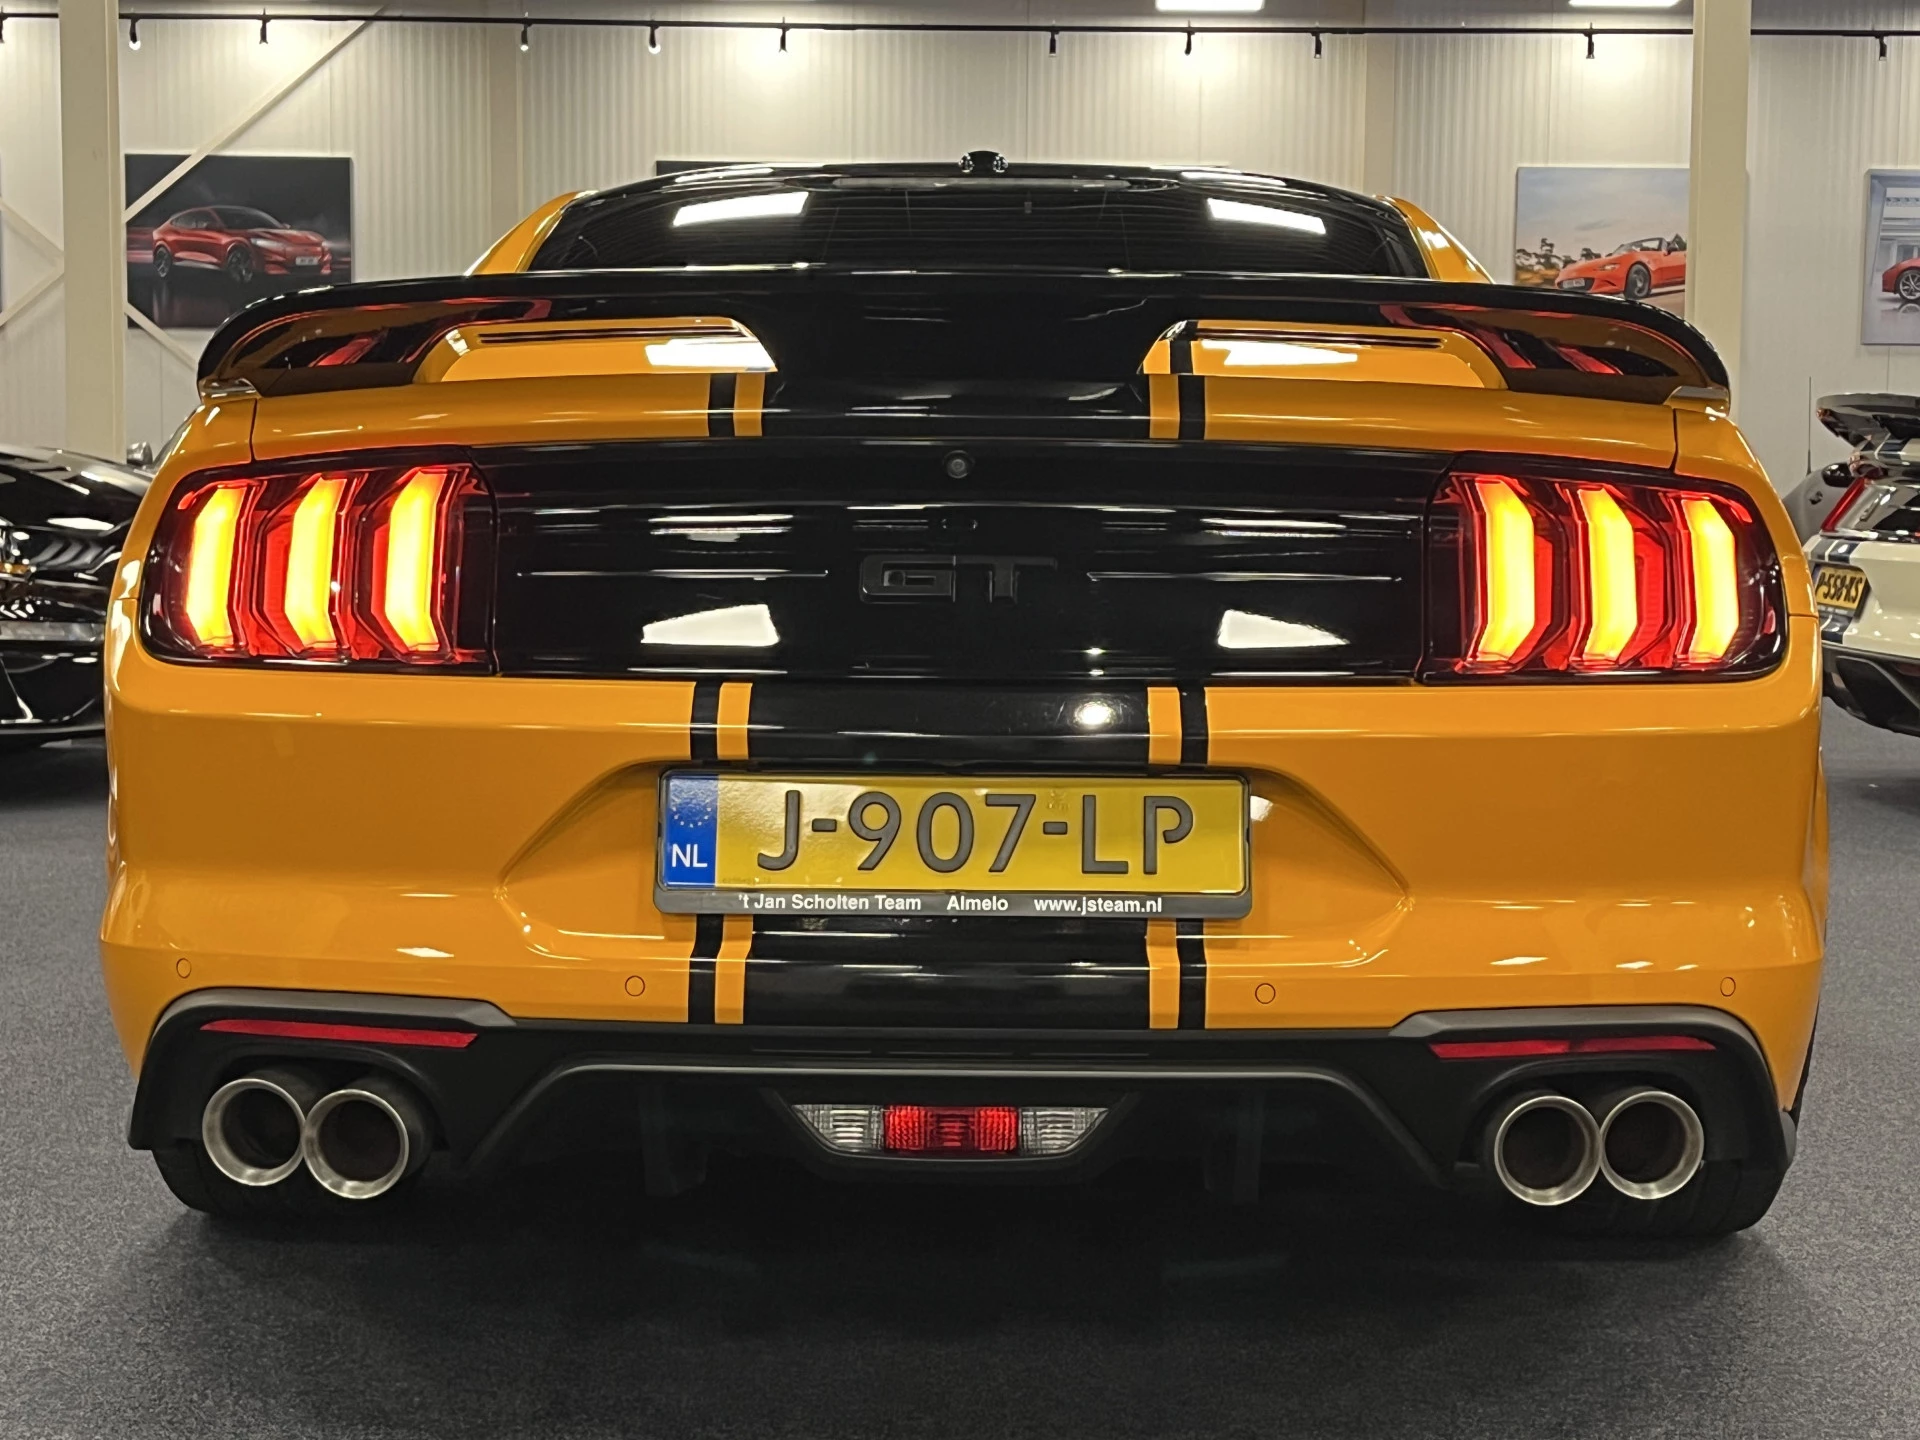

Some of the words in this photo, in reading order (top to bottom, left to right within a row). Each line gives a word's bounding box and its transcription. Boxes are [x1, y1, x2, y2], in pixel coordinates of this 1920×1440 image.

[859, 554, 1057, 604] GT
[757, 789, 1193, 875] J-907-LP
[671, 843, 708, 868] NL
[738, 895, 749, 909] 't
[754, 894, 786, 909] Jan
[791, 894, 868, 909] Scholten
[874, 895, 922, 910] Team
[946, 895, 1009, 911] Almelo
[1034, 896, 1163, 915] www.jsteam.nl
